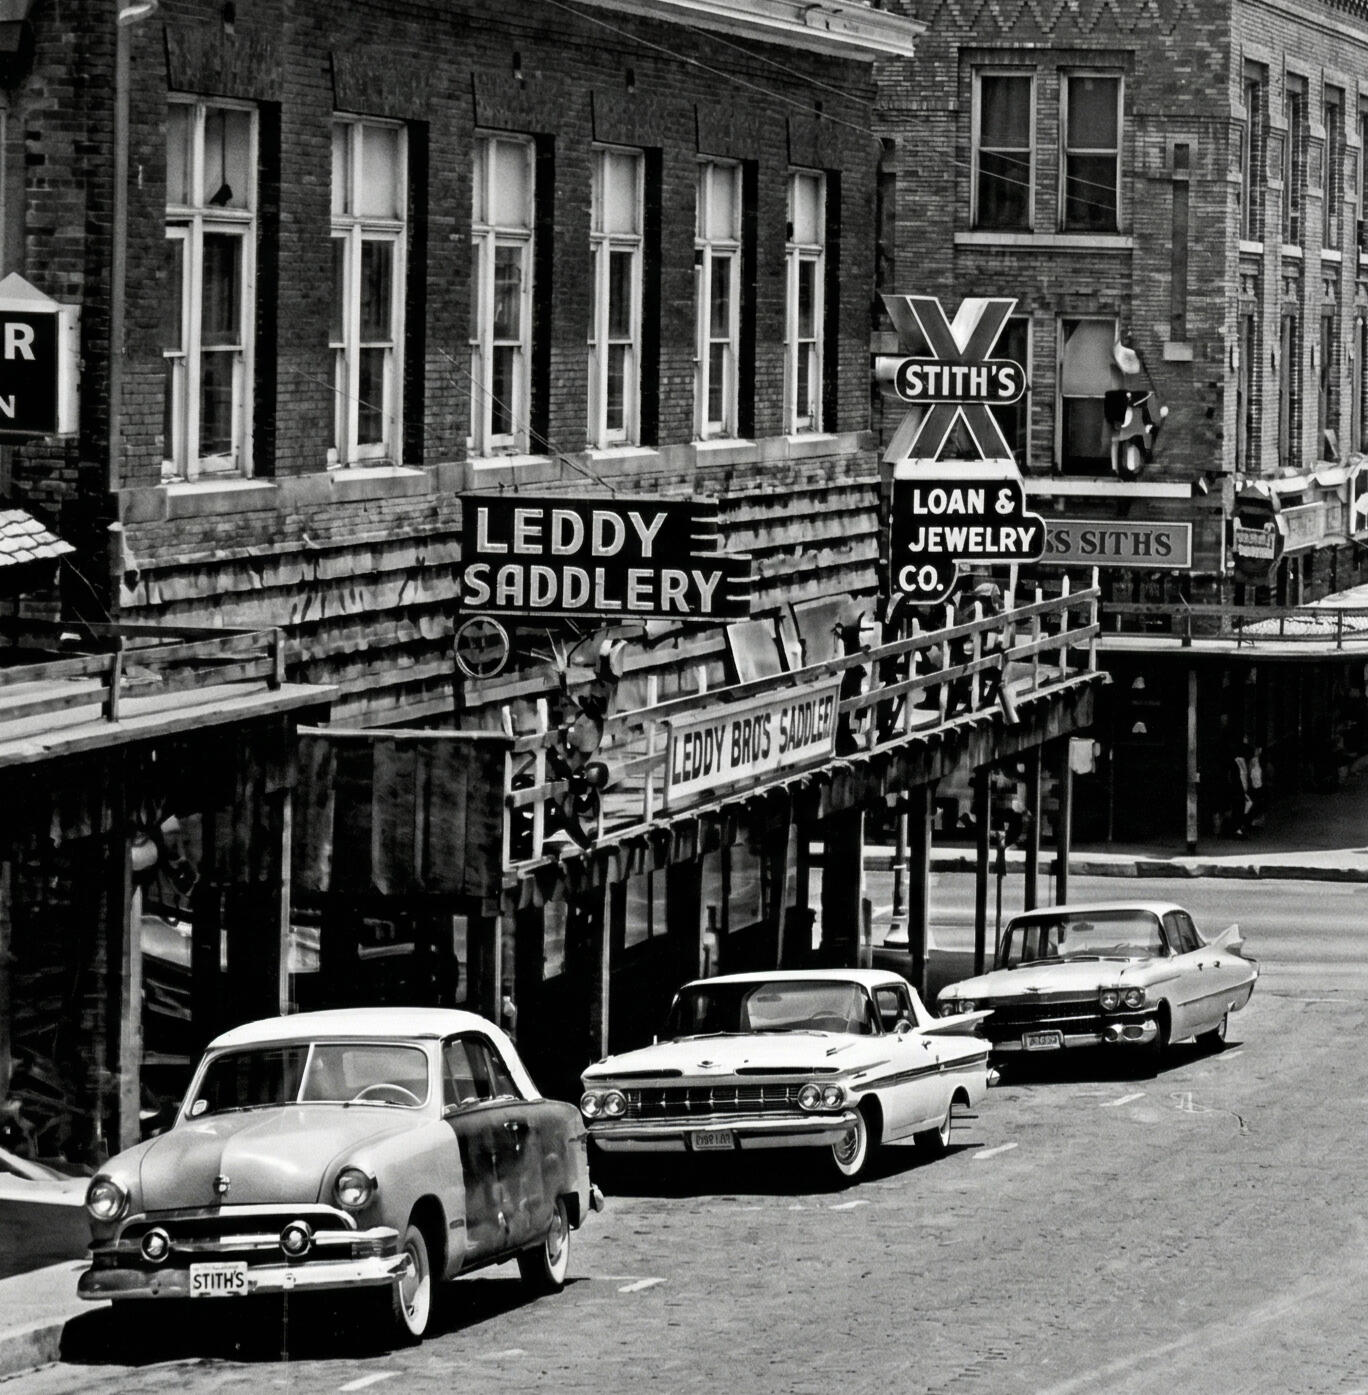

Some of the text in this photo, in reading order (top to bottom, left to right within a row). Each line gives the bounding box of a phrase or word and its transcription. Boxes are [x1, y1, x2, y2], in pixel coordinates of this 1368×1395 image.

[905, 365, 1016, 397] STITH'S
[913, 488, 1015, 515] LOAN &
[476, 507, 668, 558] LEDDY
[908, 527, 1036, 553] JEWELRY
[463, 563, 723, 613] SADDLERY
[899, 565, 944, 592] CO.
[671, 724, 726, 786] LEDDY
[193, 1270, 245, 1290] STITH'S
